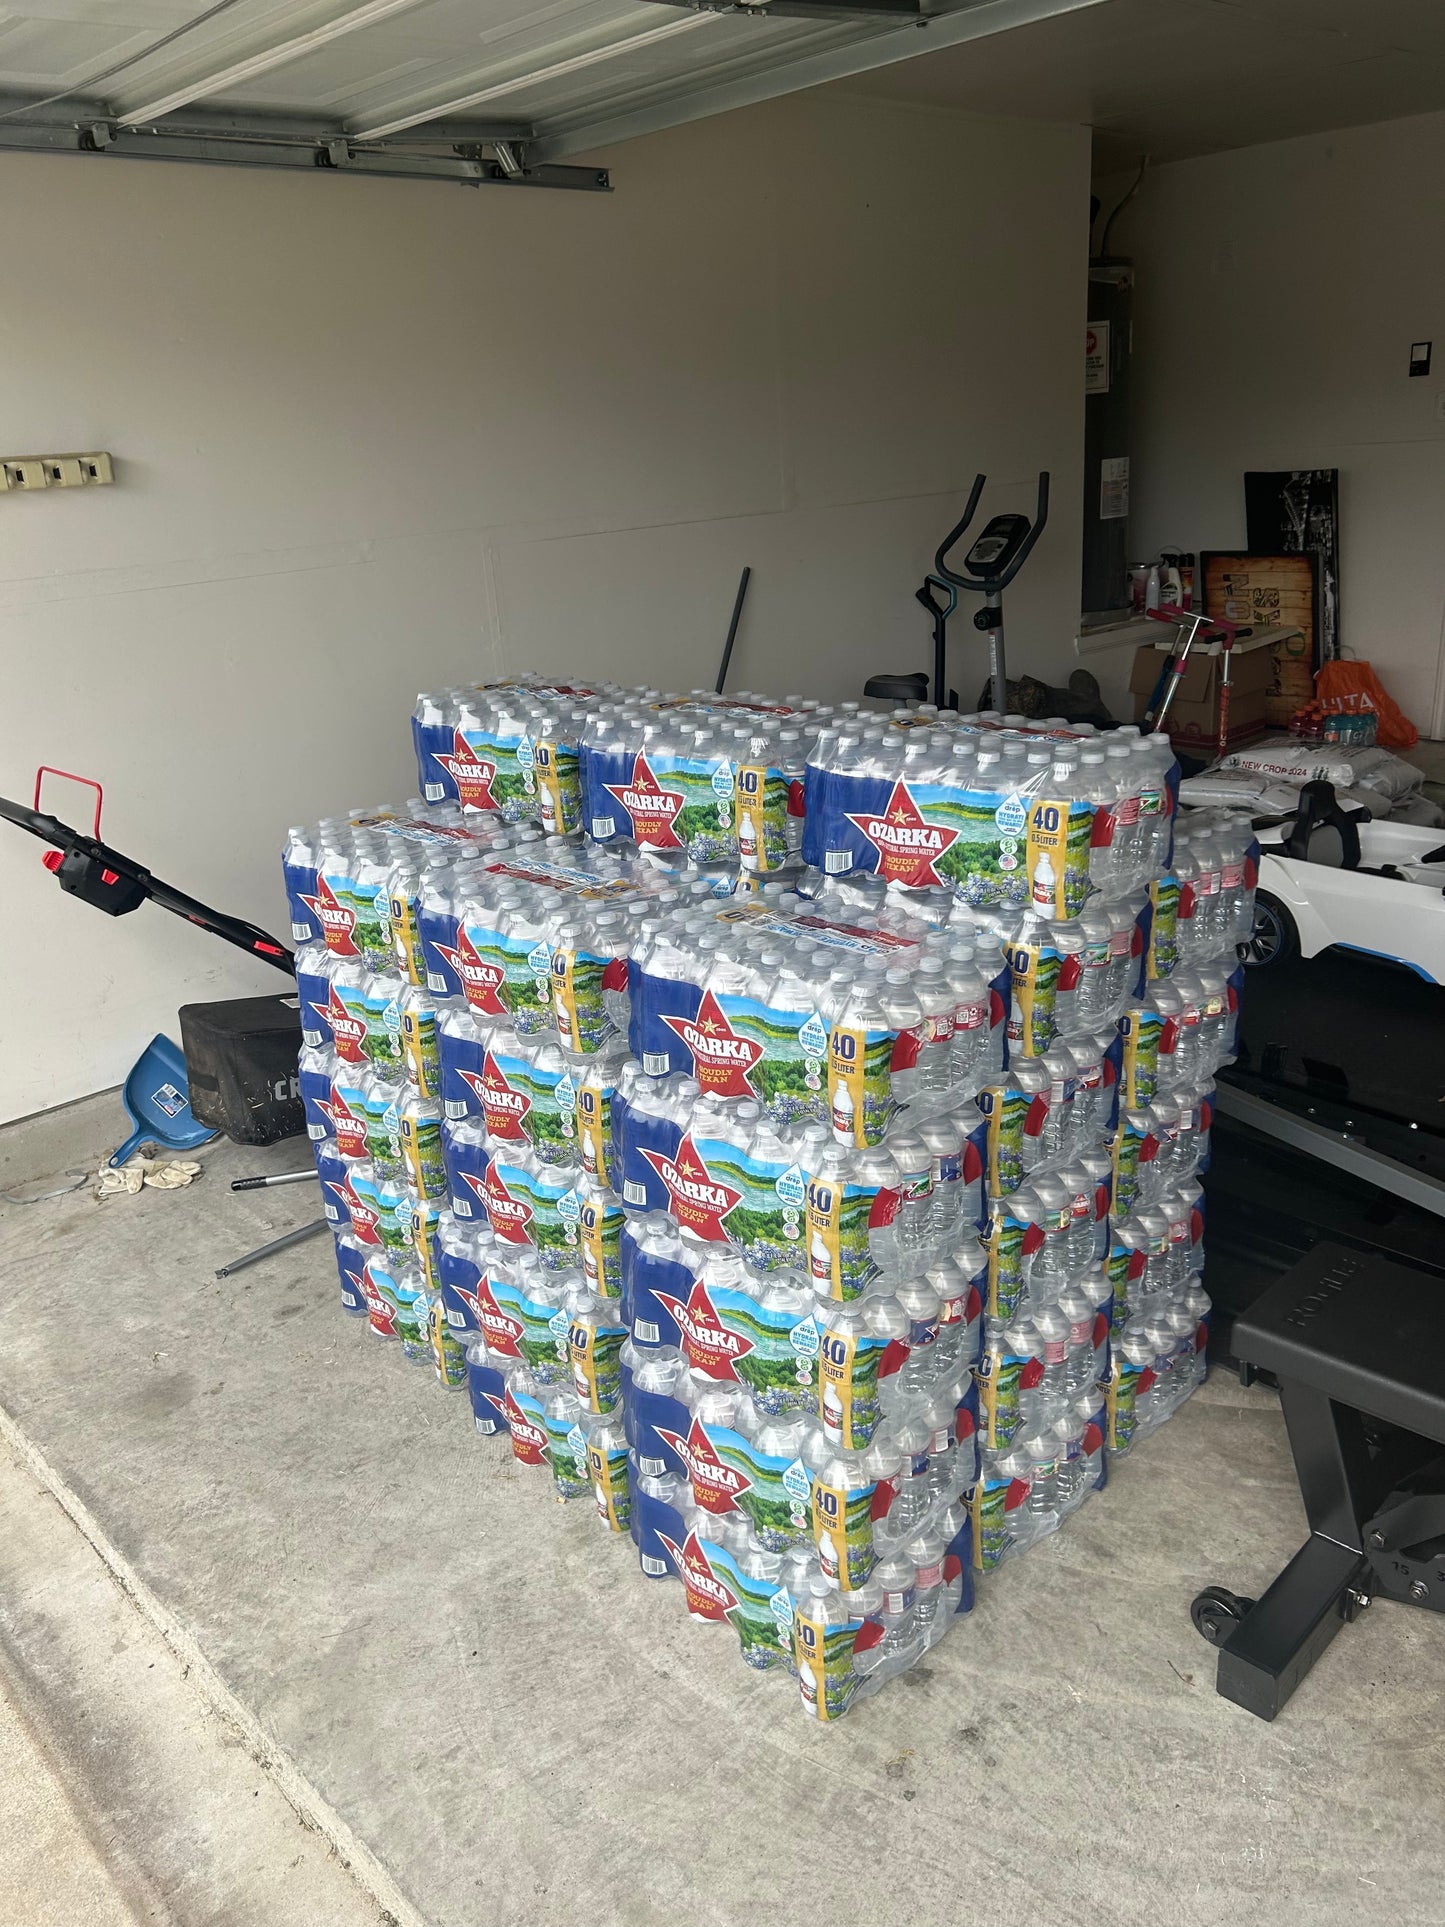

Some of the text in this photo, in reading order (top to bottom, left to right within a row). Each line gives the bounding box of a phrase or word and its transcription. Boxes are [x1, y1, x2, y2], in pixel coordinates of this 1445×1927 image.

[1241, 760, 1307, 776] NEW CROP 2024
[738, 770, 758, 793] 40
[623, 791, 676, 813] OZARKA
[1004, 804, 1020, 812] drop
[1033, 806, 1059, 832] 40
[868, 821, 943, 849] OZARKA
[1040, 834, 1058, 846] LITER
[801, 1031, 825, 1041] HYDRATE
[807, 1024, 822, 1034] drop
[683, 1025, 752, 1062] OZARKA
[832, 1031, 856, 1060] 40
[837, 1062, 856, 1075] LITER
[474, 1080, 524, 1112] OZARKA
[579, 1089, 595, 1112] 40
[661, 1162, 728, 1208] OZARKA
[785, 1174, 801, 1185] drop
[808, 1183, 833, 1213] 40
[815, 1214, 831, 1227] LITER
[568, 1325, 588, 1350] 40
[673, 1304, 739, 1354] OZARKA
[793, 1331, 818, 1344] HYDRATE
[799, 1327, 815, 1336] drop
[822, 1336, 847, 1366] 40
[827, 1364, 844, 1380] LITER
[675, 1439, 739, 1490] OZARKA
[790, 1470, 804, 1480] drop
[816, 1487, 838, 1516] 40
[821, 1514, 837, 1529] LITER
[1392, 1561, 1410, 1576] 15
[795, 1617, 815, 1647] 40
